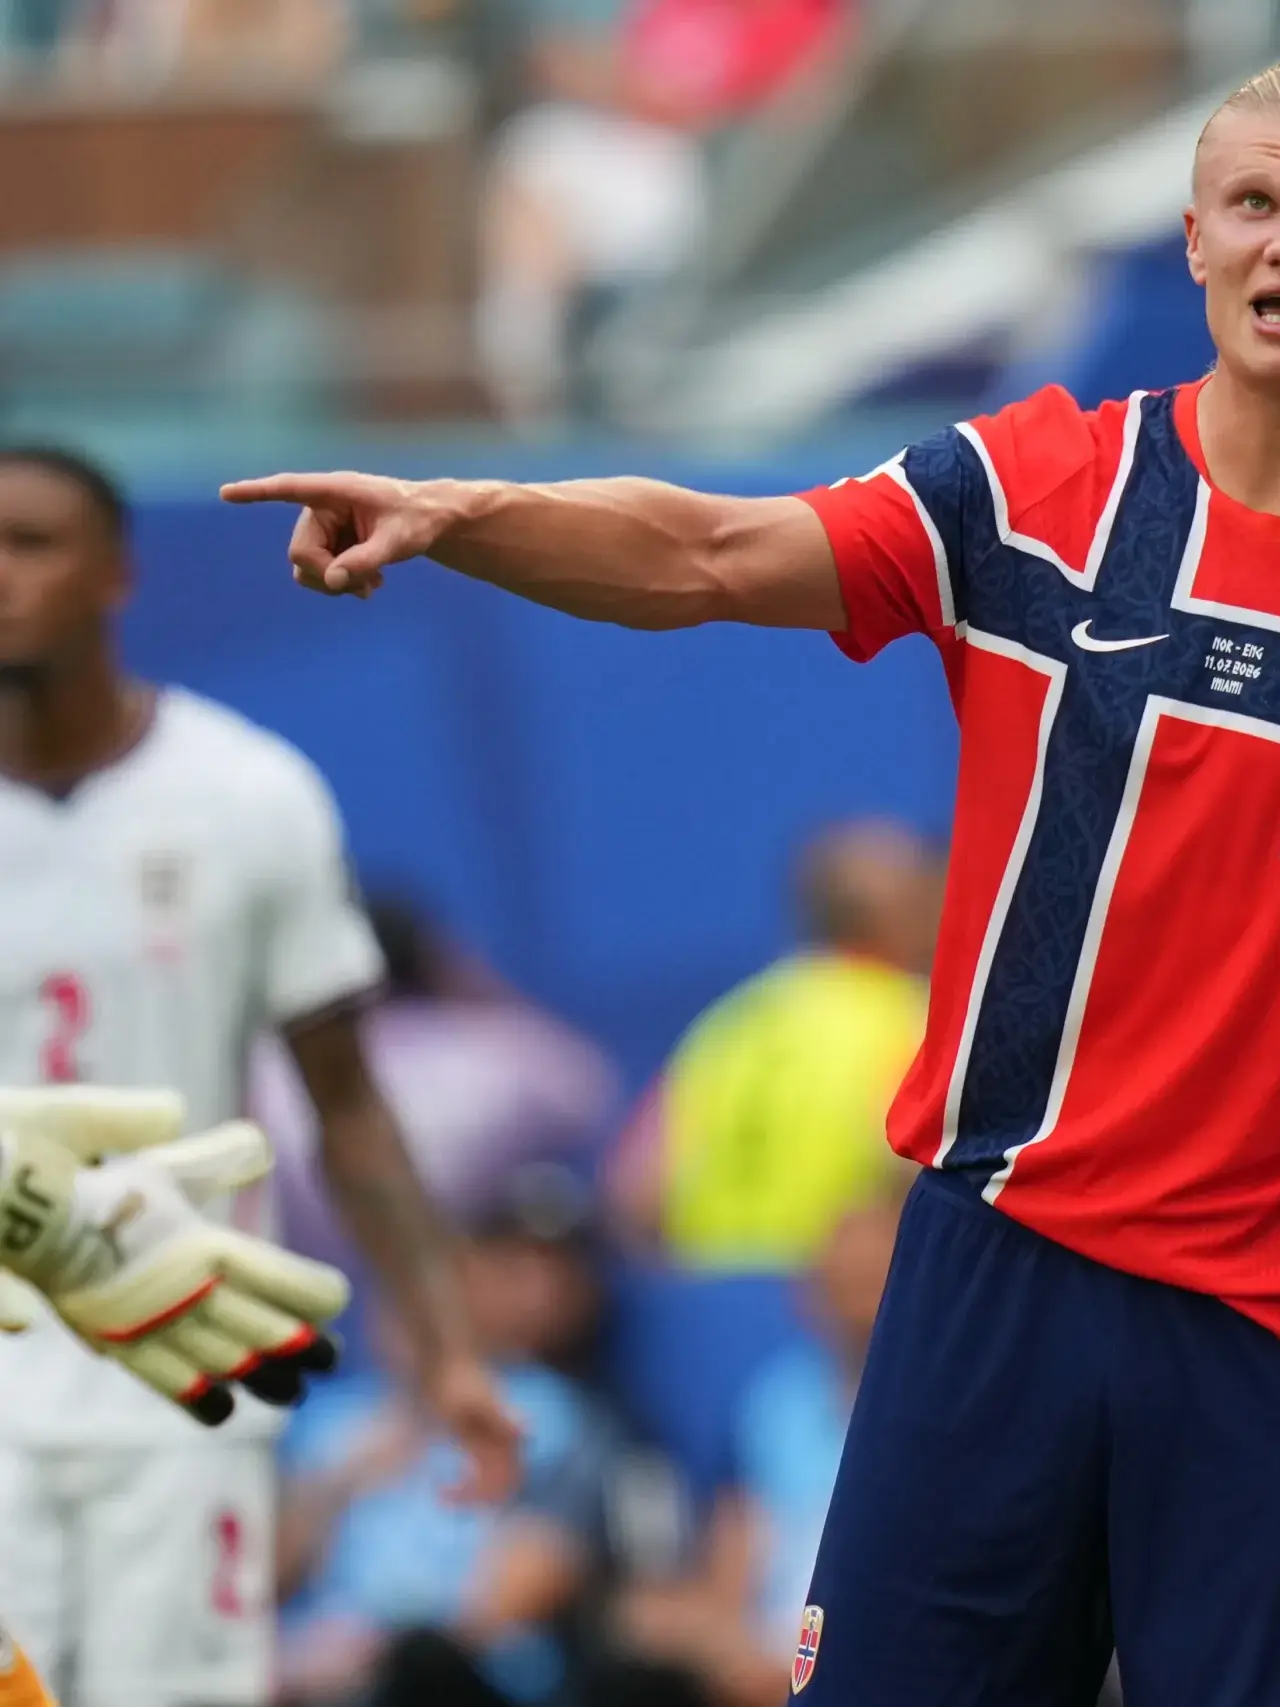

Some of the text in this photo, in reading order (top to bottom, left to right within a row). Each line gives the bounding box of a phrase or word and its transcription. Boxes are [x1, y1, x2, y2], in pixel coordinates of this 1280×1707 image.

[1212, 636, 1233, 653] NOR
[1242, 643, 1264, 660] ENG
[1205, 655, 1261, 679] 11.07.2026
[1210, 677, 1243, 695] MIAMI
[38, 970, 92, 1084] 2
